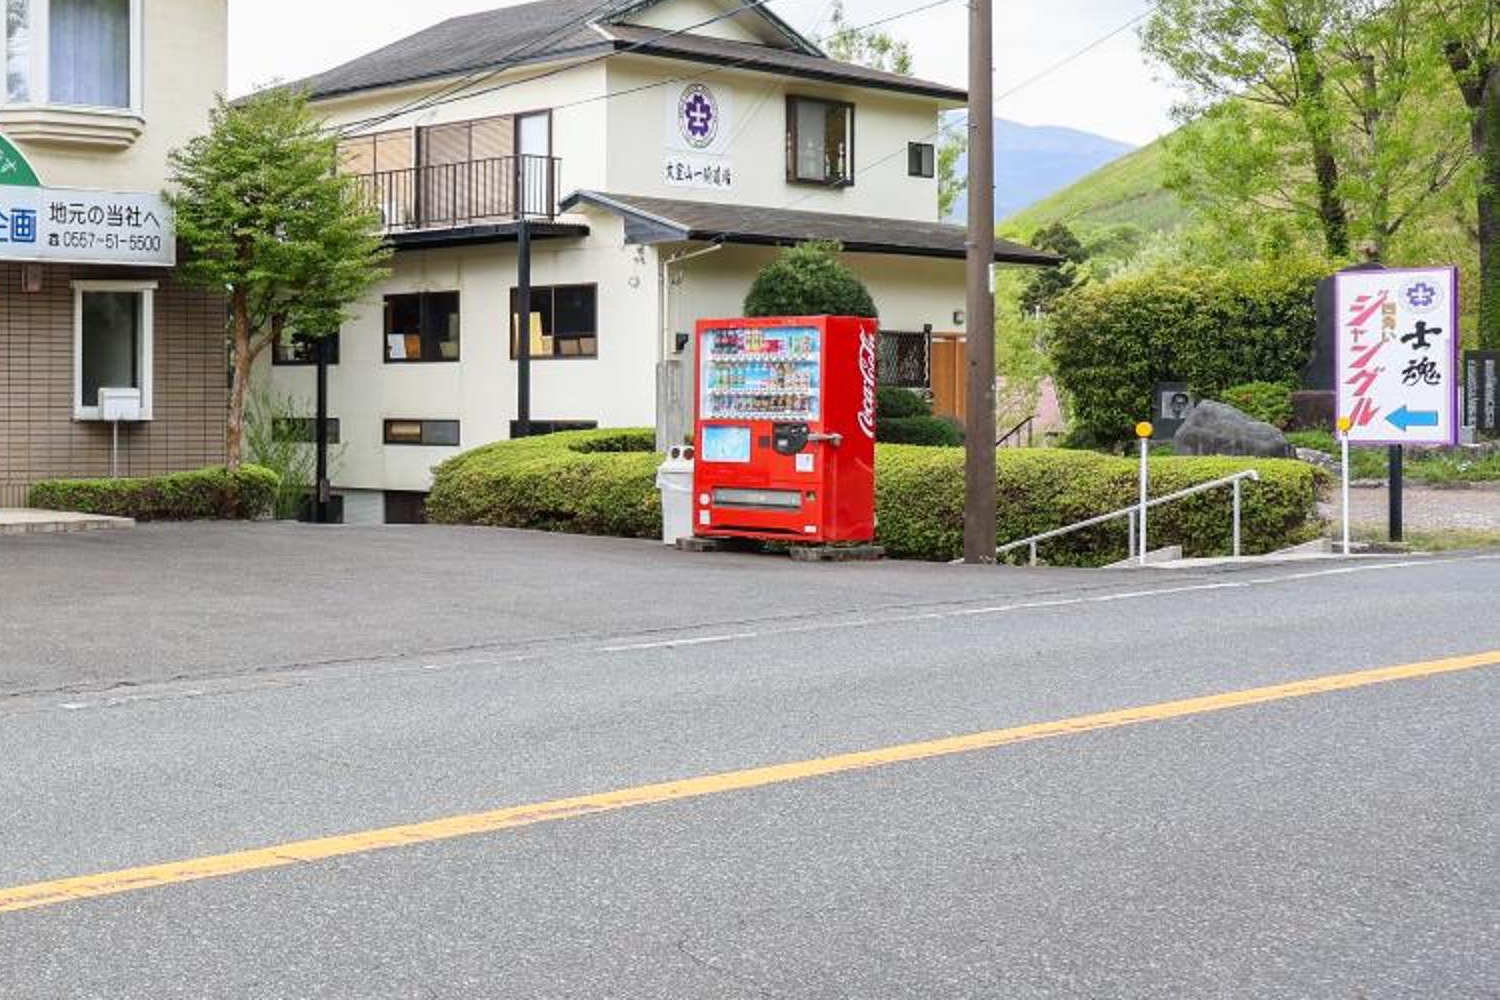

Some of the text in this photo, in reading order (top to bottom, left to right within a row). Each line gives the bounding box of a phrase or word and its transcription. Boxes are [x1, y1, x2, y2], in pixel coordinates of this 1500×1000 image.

[49, 202, 160, 229] 地元の当社へ
[1345, 290, 1388, 427] ジャングル
[1401, 320, 1443, 386] 士魂
